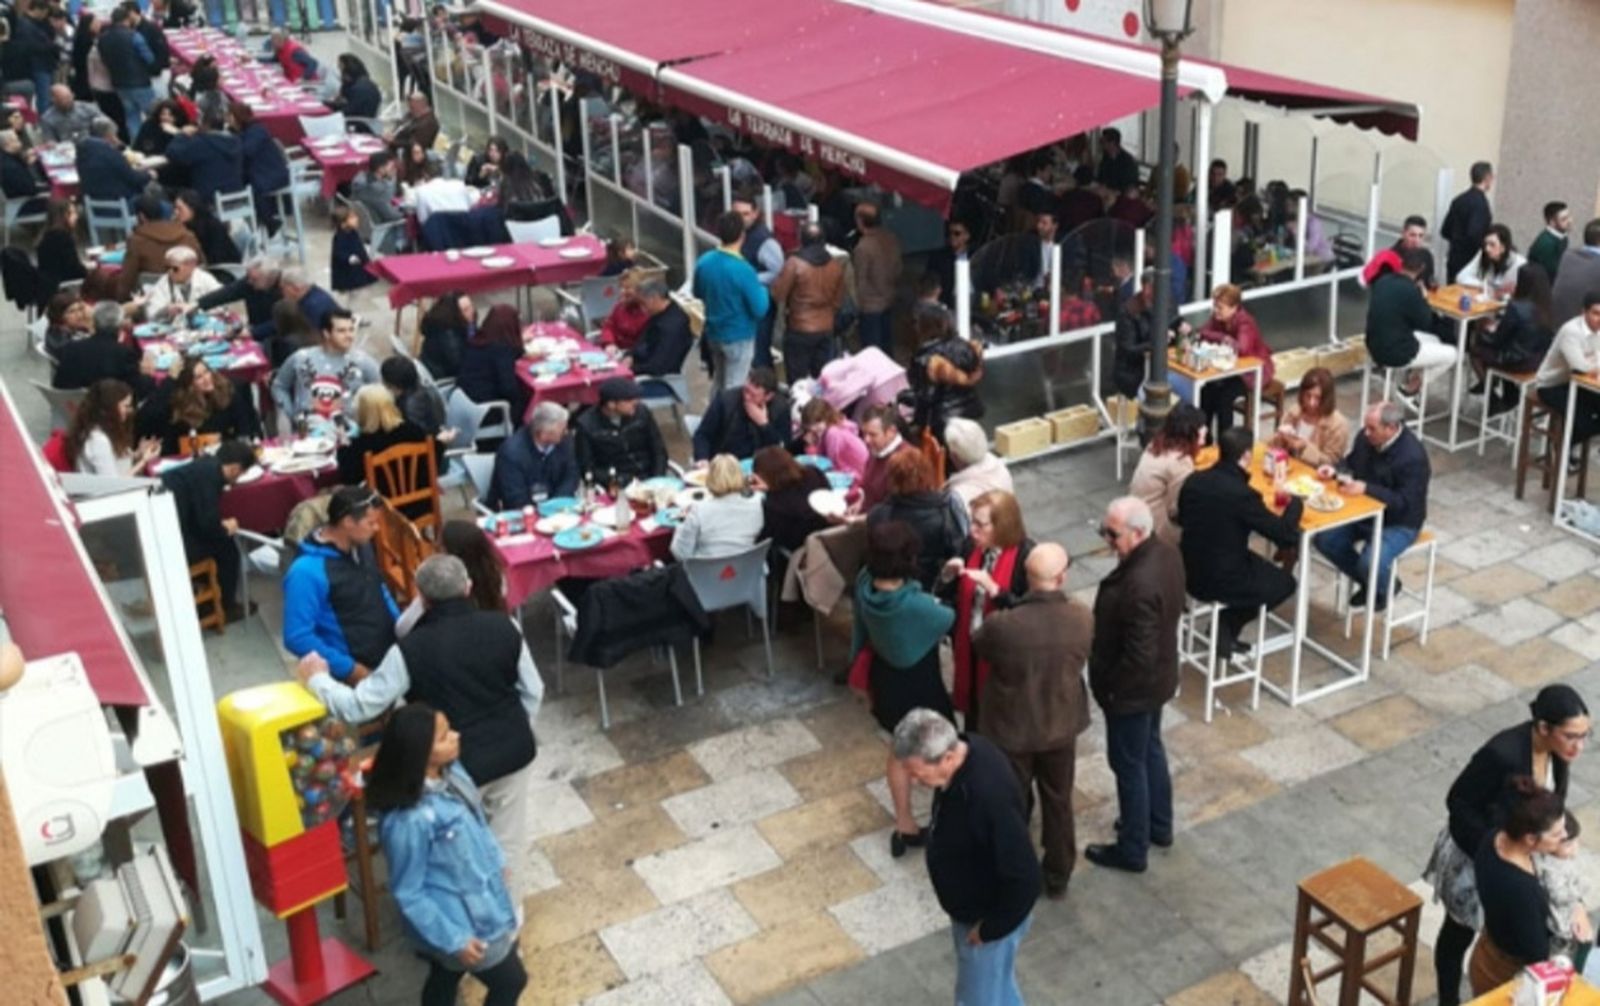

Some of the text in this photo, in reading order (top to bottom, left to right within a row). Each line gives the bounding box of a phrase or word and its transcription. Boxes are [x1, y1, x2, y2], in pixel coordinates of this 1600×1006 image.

[509, 24, 521, 41] LA
[563, 44, 577, 67] DE
[727, 105, 741, 126] LA
[745, 112, 793, 147] TERRAZA
[800, 134, 814, 154] DE
